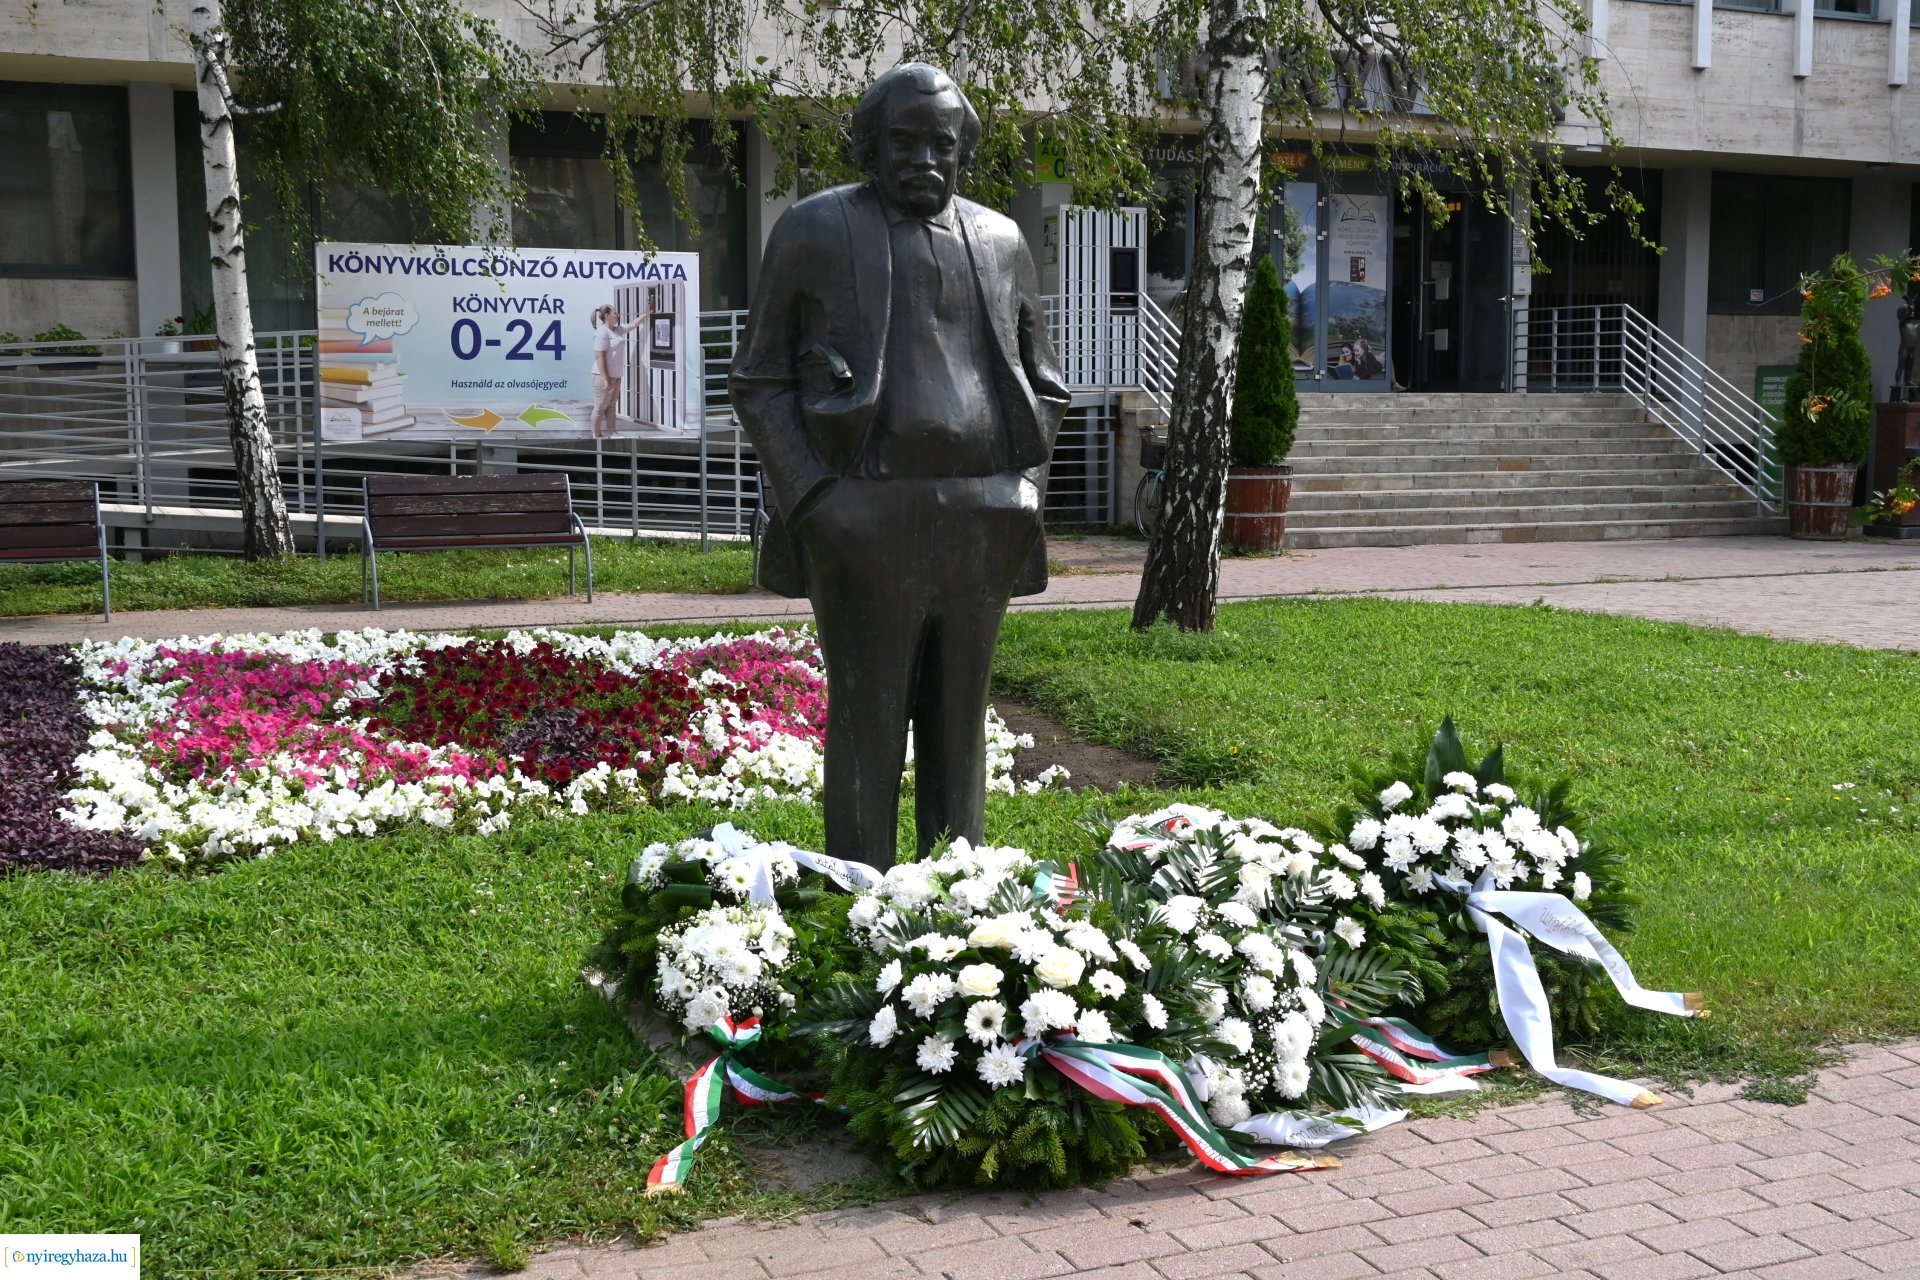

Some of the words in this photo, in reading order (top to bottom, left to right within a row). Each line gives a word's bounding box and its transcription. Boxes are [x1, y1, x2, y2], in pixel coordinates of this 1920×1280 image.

[329, 250, 559, 279] KÖNYVKÖLCSÖNZŐ
[562, 260, 688, 282] AUTOMATA
[363, 307, 370, 315] A
[372, 306, 404, 317] bejárat
[452, 293, 566, 315] KÖNYVTÁR
[366, 319, 402, 328] mellett!
[450, 318, 567, 361] 0-24
[451, 379, 493, 389] Használd
[494, 381, 505, 389] az
[506, 379, 568, 391] olvasójegyed!
